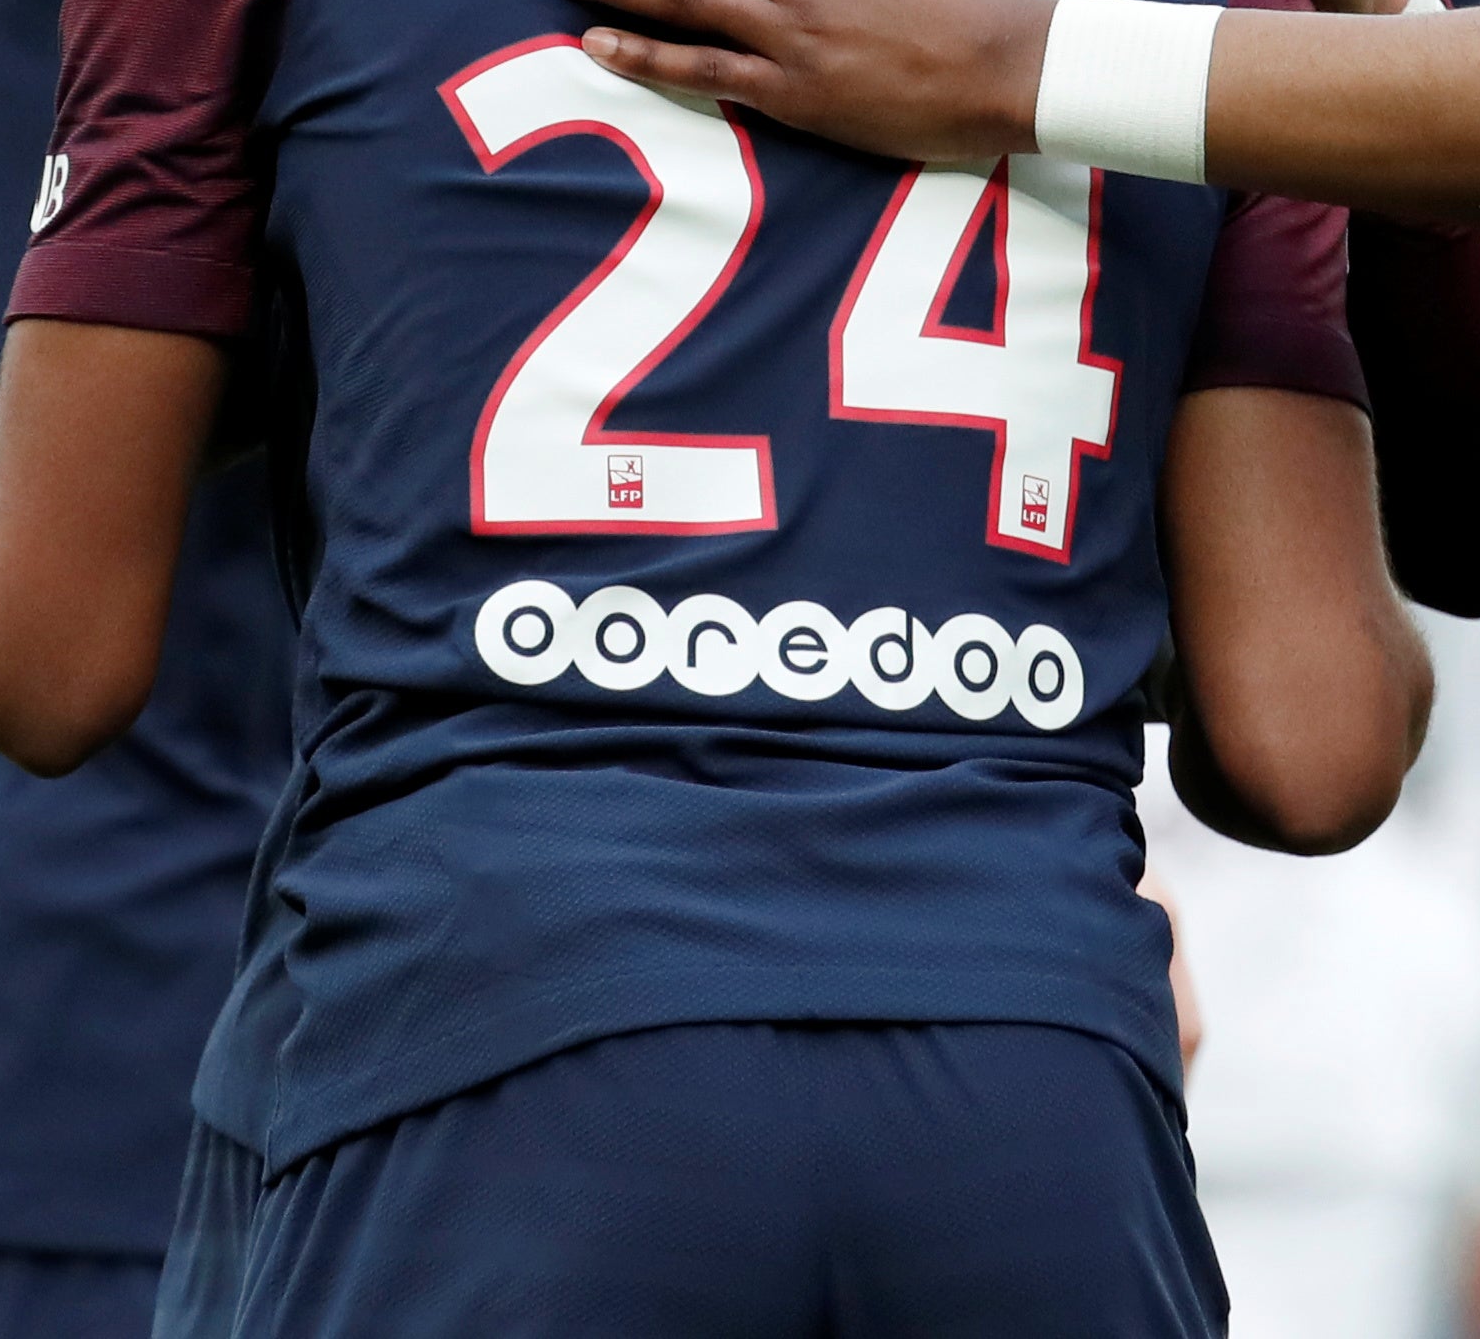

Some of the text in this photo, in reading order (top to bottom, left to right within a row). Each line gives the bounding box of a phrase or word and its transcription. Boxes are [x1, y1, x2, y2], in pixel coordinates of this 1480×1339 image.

[437, 33, 1123, 565] 24
[610, 489, 642, 502] LFP
[1022, 508, 1047, 525] LFP
[495, 600, 1070, 708] ooredoo
